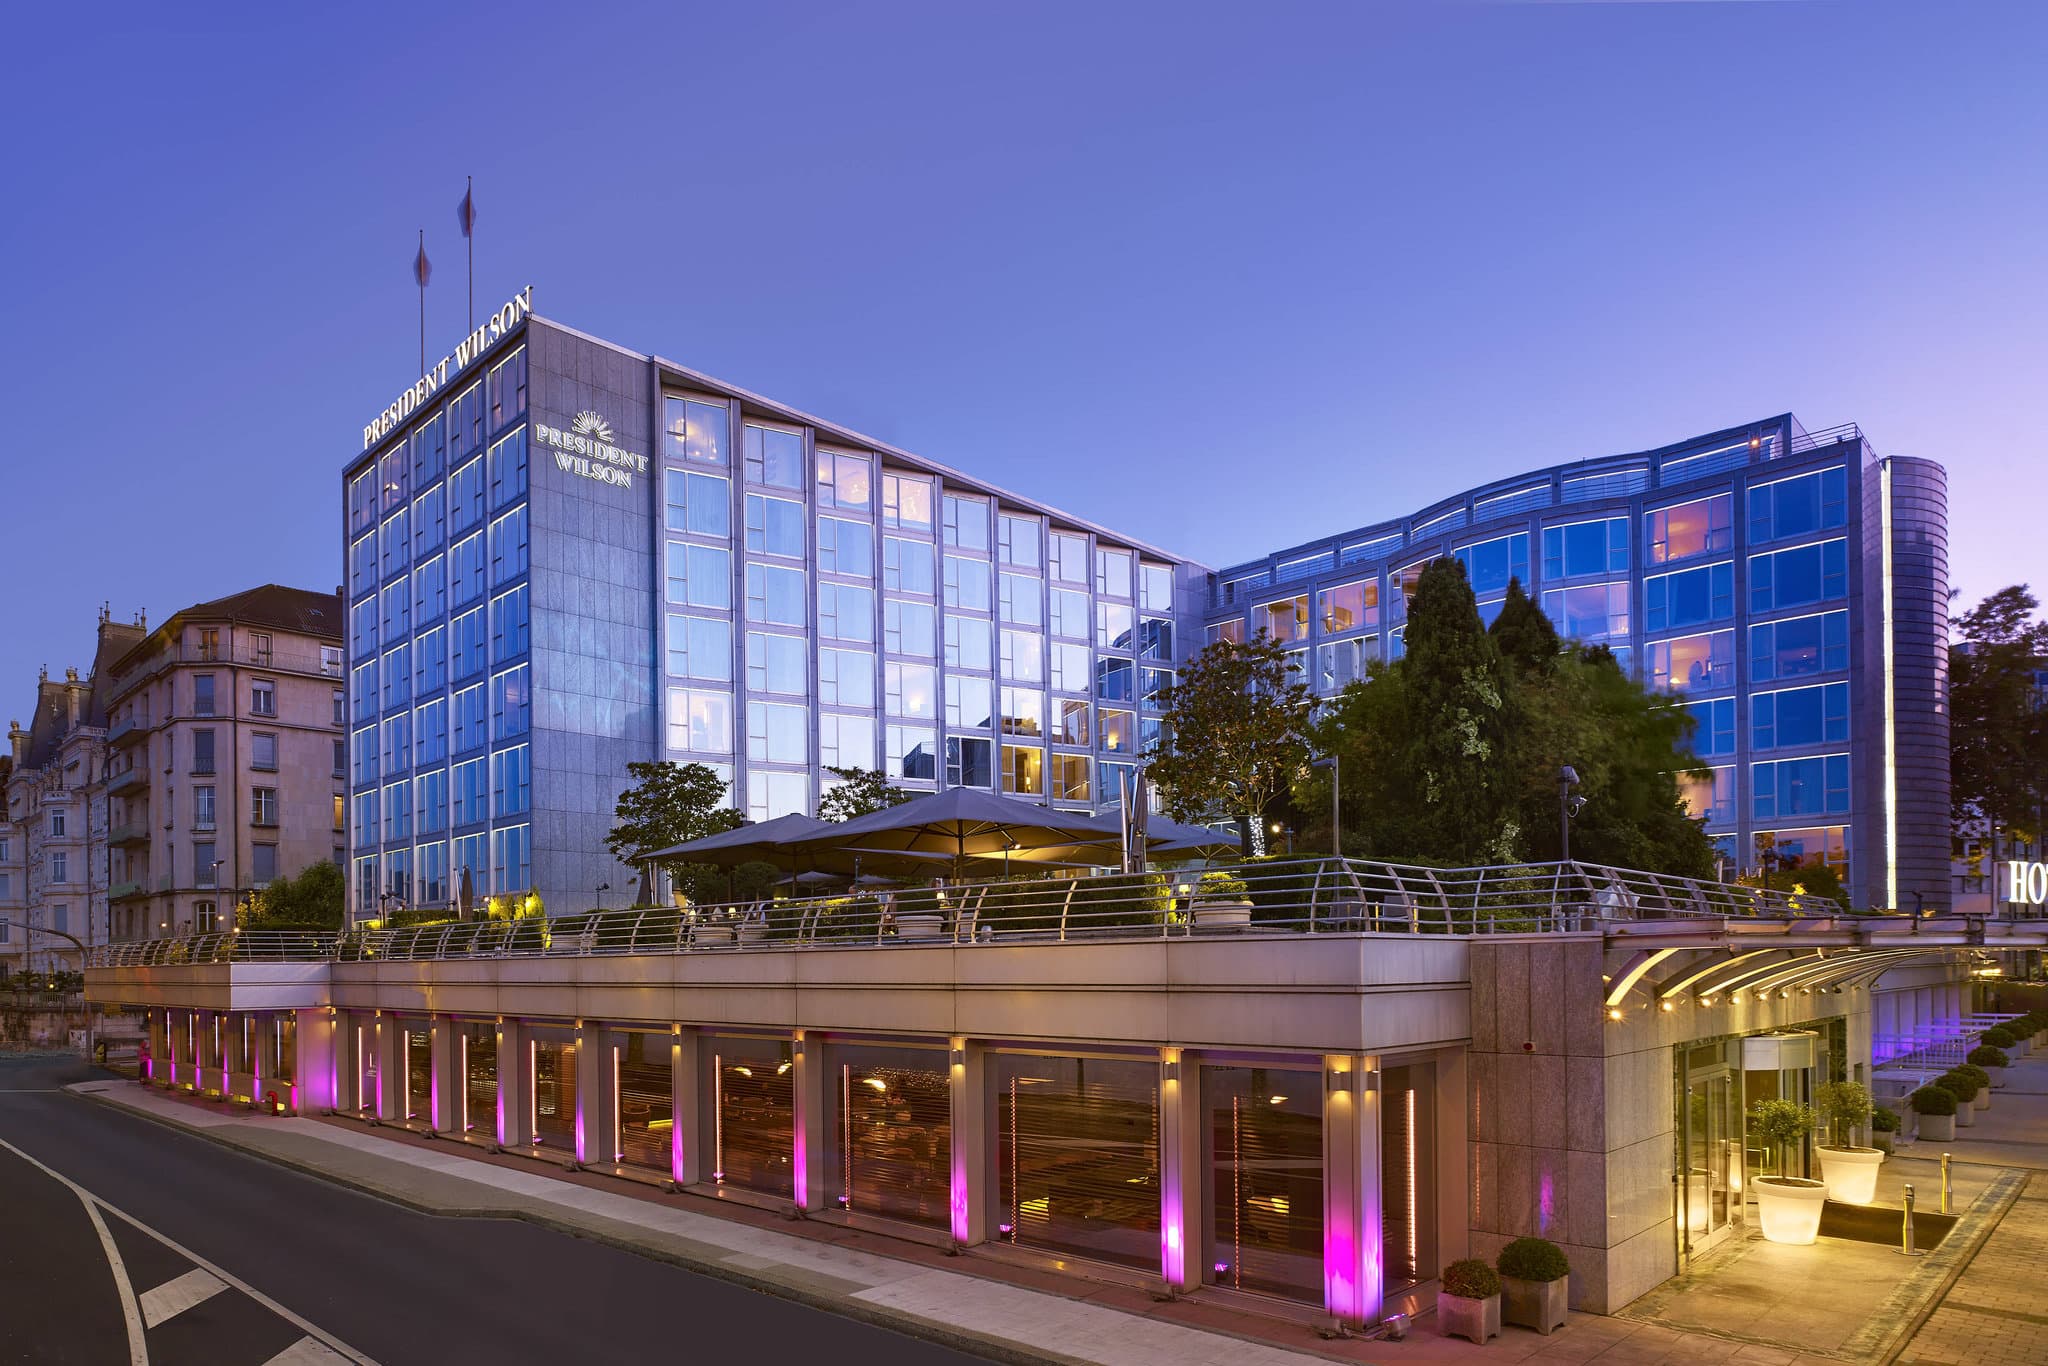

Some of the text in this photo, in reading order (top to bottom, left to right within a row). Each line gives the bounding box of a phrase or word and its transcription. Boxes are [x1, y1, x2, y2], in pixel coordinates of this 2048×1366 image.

[363, 285, 533, 449] PRESIDENT WILSON
[535, 423, 648, 472] PRESIDENT
[554, 451, 632, 489] WILSON
[2008, 860, 2048, 905] HO
